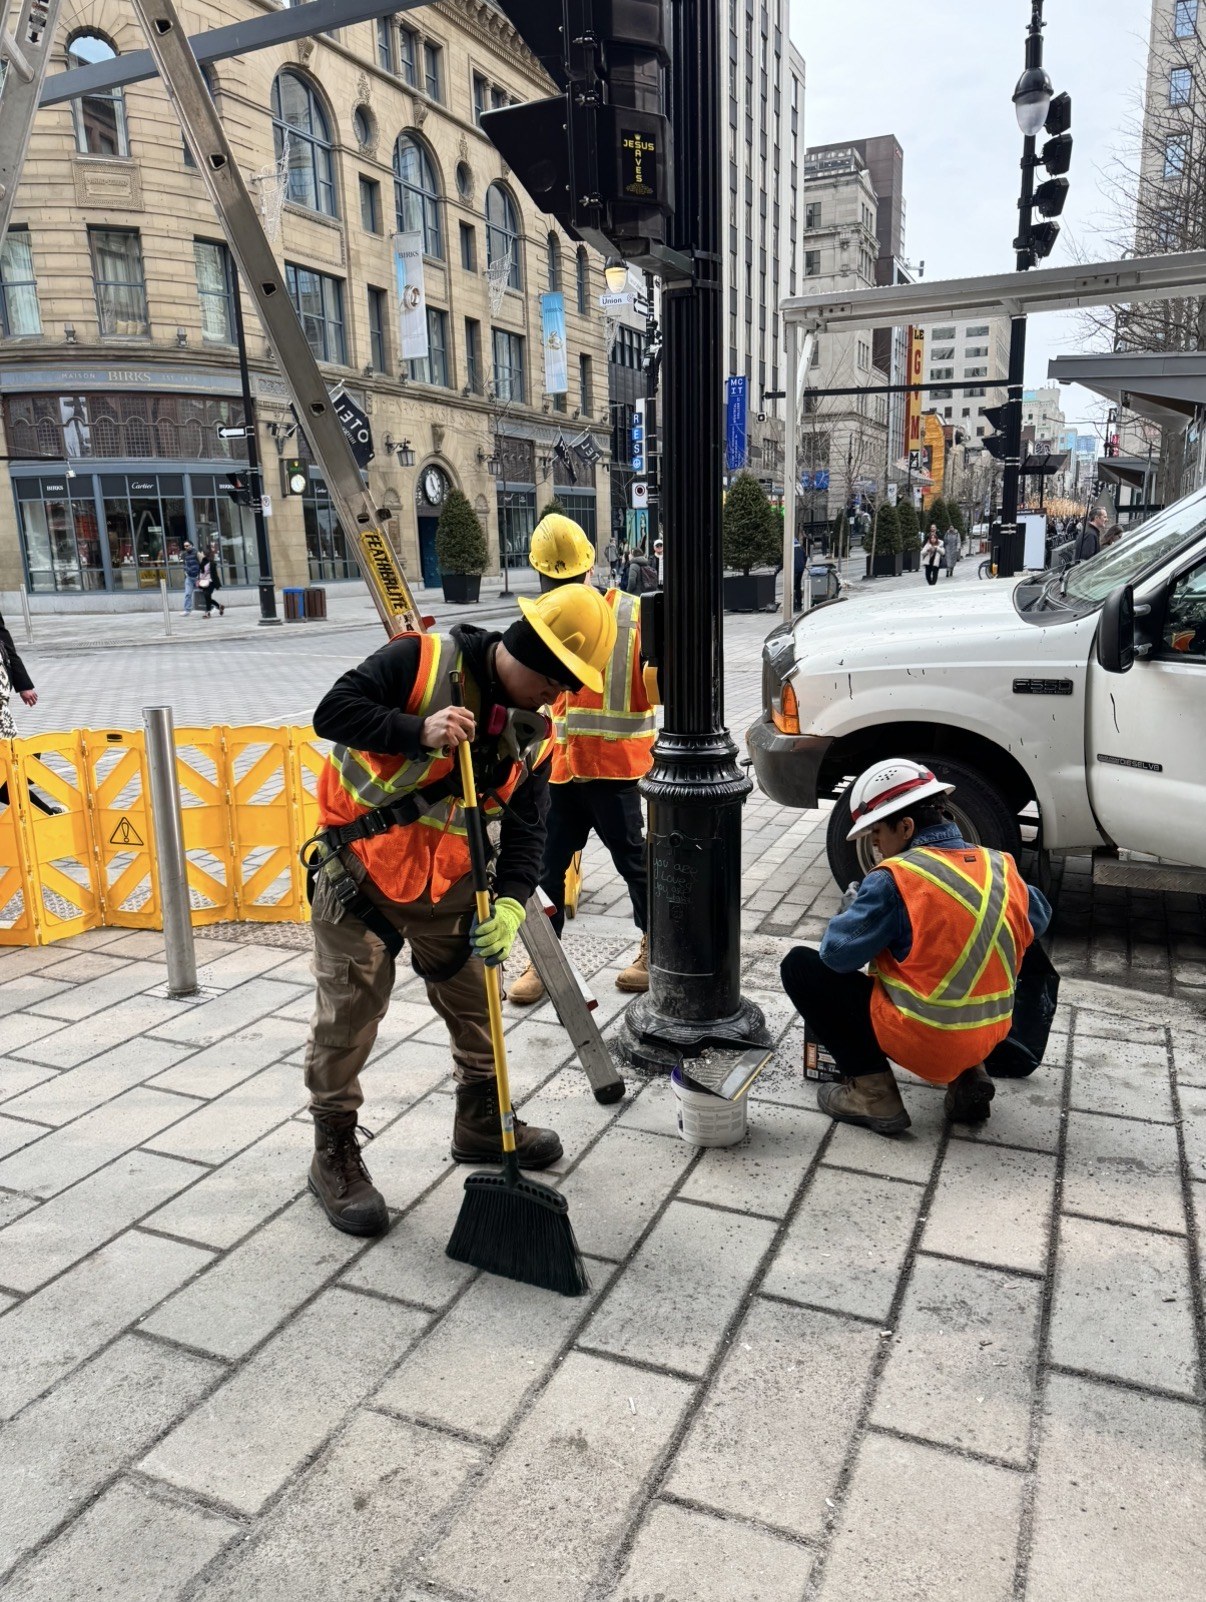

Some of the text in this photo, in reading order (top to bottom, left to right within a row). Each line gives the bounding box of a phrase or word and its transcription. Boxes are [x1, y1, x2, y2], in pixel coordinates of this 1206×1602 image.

[623, 139, 655, 151] JESUS
[398, 250, 420, 259] BIRKS
[914, 329, 924, 340] LE
[61, 372, 96, 380] MAISON
[108, 370, 152, 382] BIRKS
[131, 481, 154, 491] Cartier
[364, 533, 409, 610] FEATHERLITE
